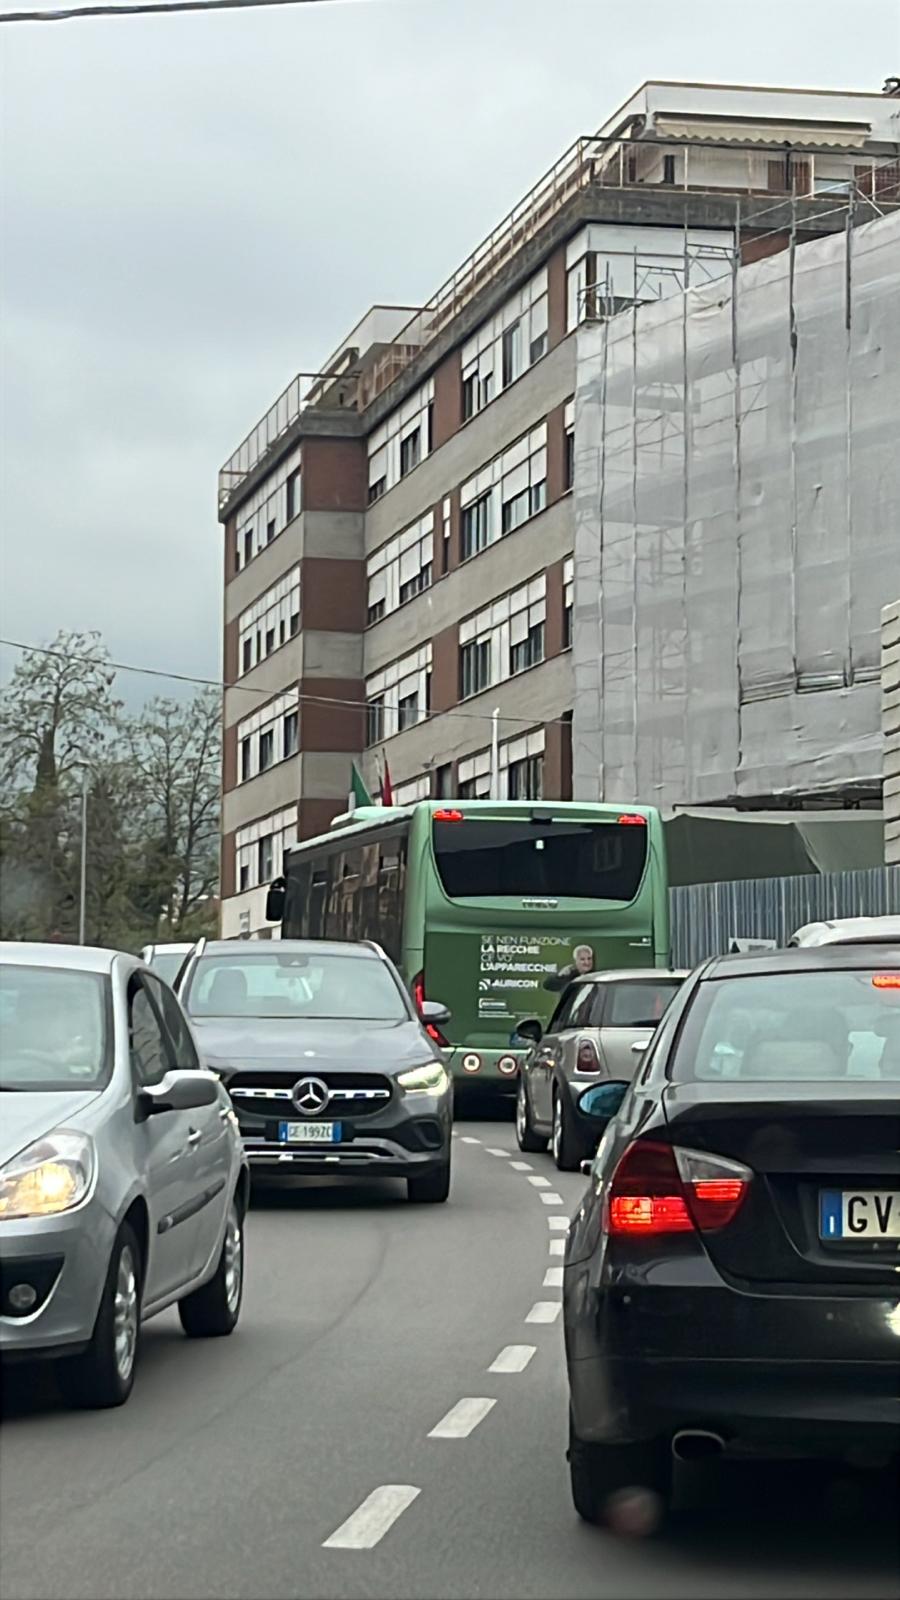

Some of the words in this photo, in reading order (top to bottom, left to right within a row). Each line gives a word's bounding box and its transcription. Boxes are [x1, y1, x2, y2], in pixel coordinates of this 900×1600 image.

[481, 935, 494, 944] SE
[520, 936, 570, 945] FUNZIONE
[481, 944, 495, 953] LA
[497, 945, 540, 954] RECCHIE
[492, 979, 538, 988] AURICON
[848, 1196, 893, 1233] GV
